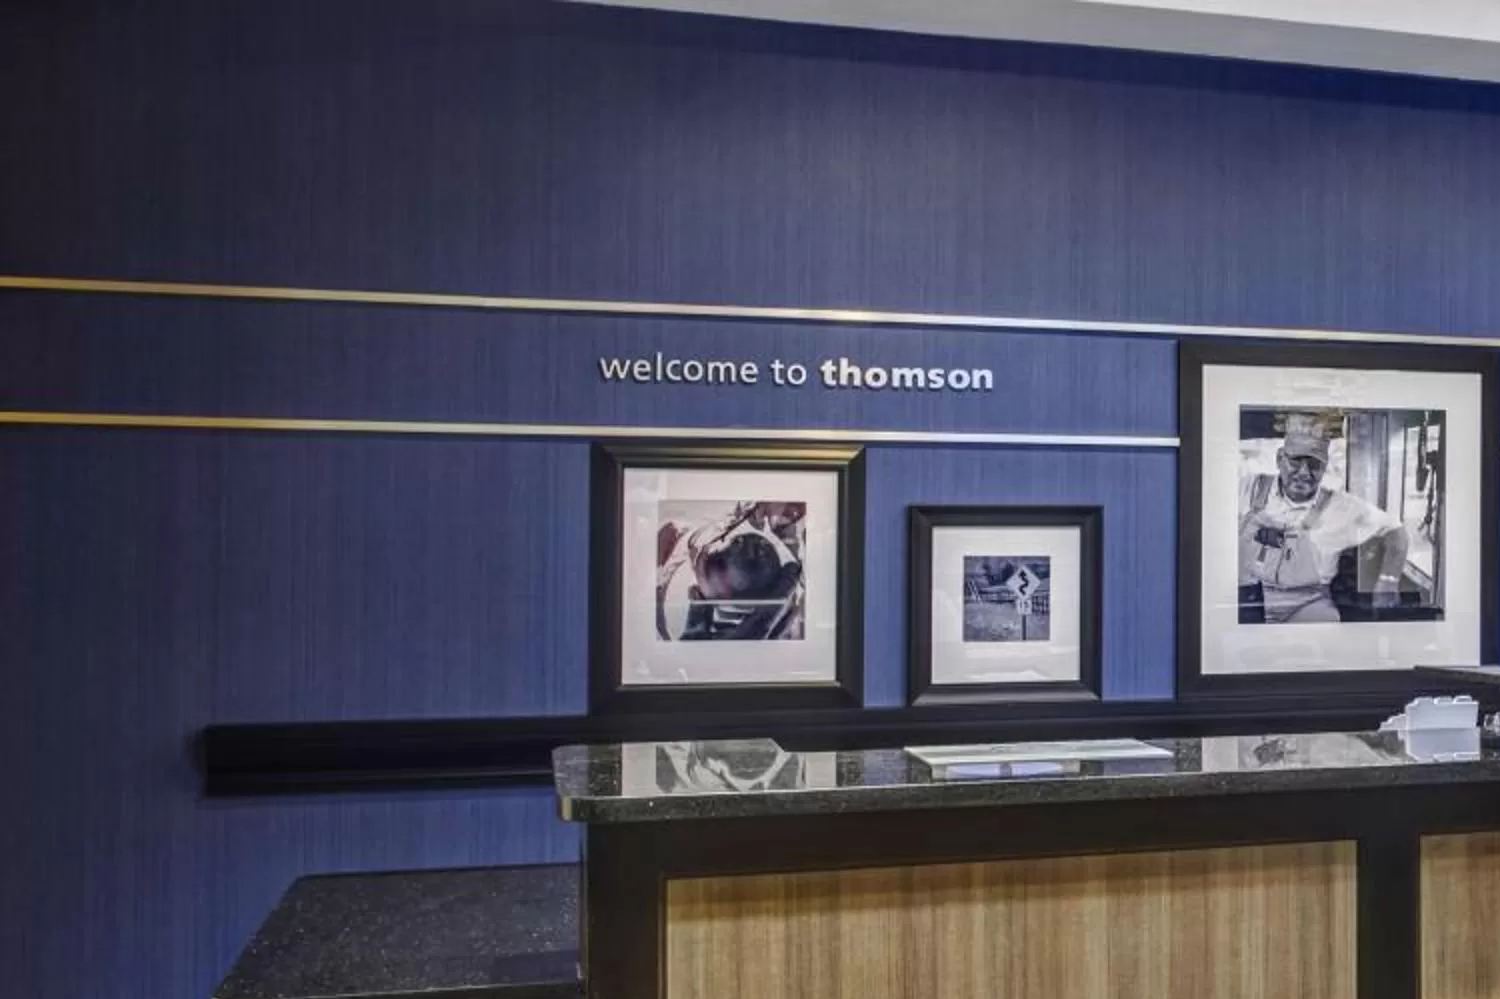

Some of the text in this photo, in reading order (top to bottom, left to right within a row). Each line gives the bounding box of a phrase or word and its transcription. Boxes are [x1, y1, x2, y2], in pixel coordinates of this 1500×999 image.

[600, 352, 994, 390] welcome to thomson
